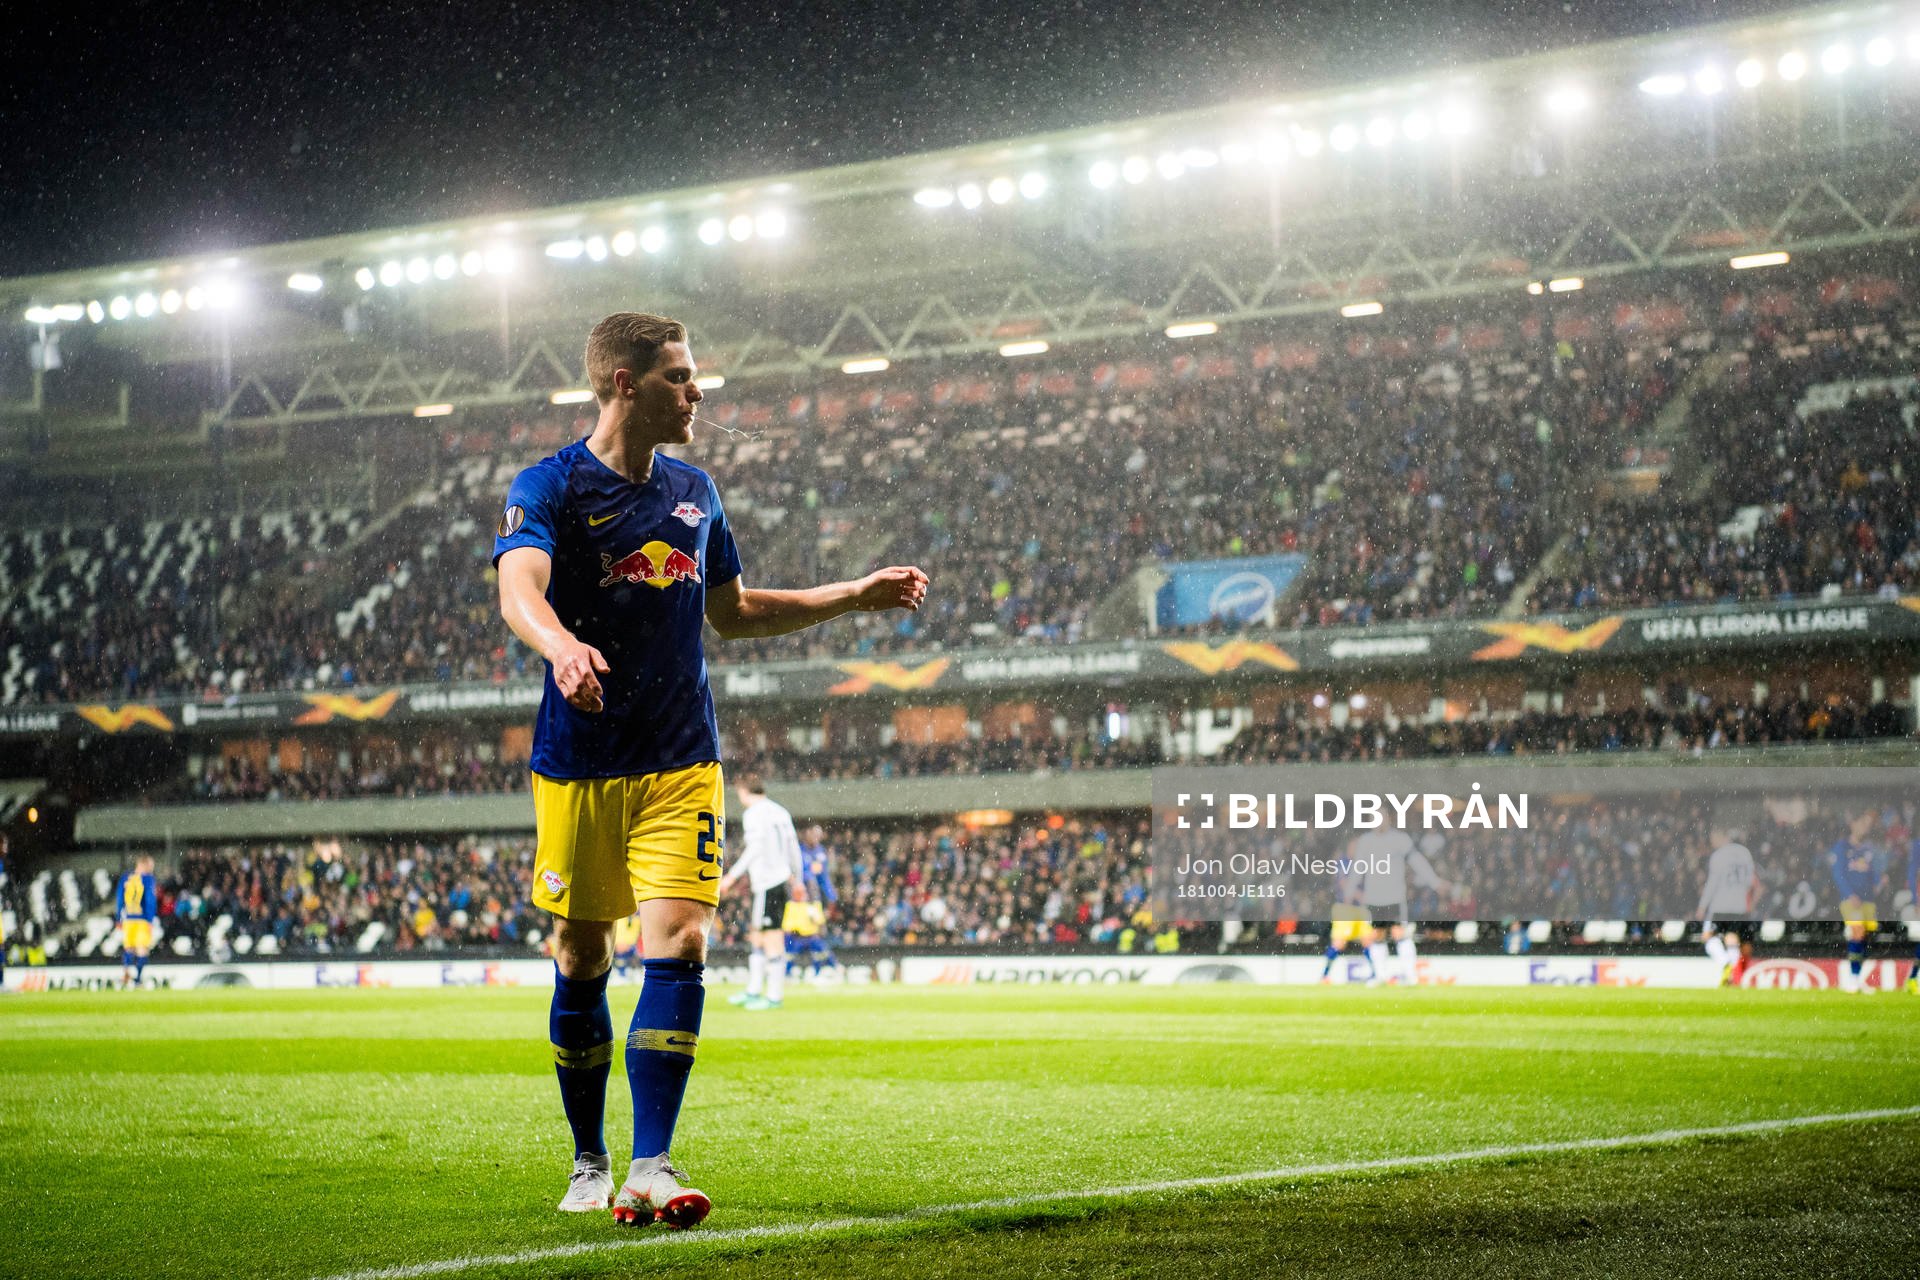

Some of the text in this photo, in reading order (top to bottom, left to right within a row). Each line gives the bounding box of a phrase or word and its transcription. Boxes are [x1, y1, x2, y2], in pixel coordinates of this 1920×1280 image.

[1641, 606, 1868, 641] UEFA EUROPA LEAGUE
